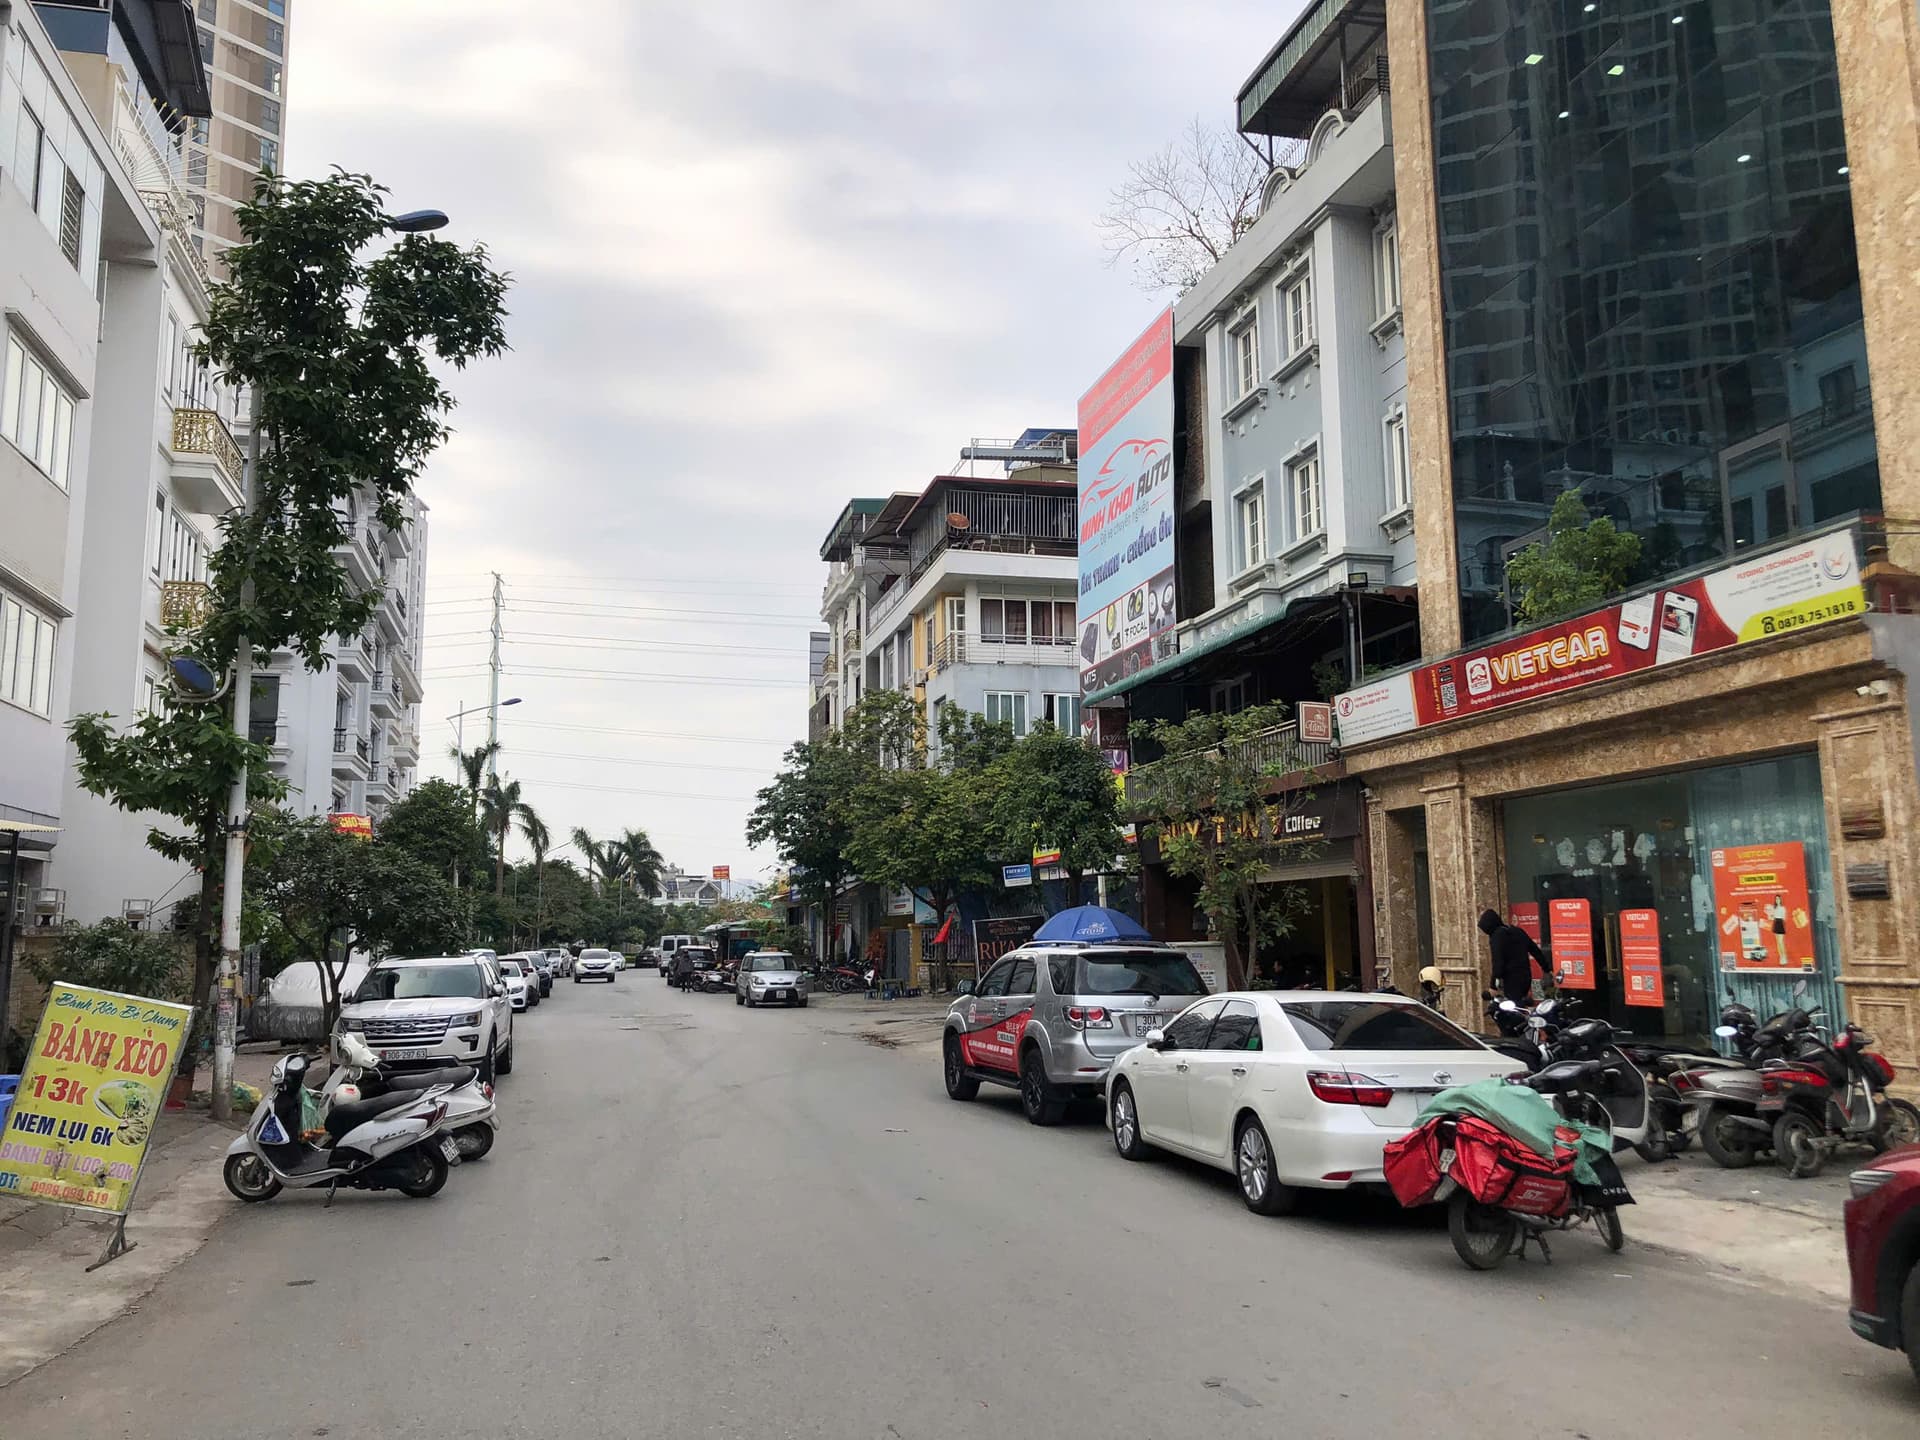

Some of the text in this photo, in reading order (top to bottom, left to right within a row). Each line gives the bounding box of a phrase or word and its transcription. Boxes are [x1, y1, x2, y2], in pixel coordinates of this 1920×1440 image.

[1080, 507, 1106, 545] MINH
[1137, 453, 1171, 501] AUTO
[1129, 619, 1148, 638] FOCAL
[1777, 600, 1856, 630] 0878.75.1818
[1490, 625, 1610, 684] VIETCAR
[1084, 668, 1097, 685] MTS
[1142, 1015, 1157, 1025] 30A
[41, 1016, 118, 1068] BÁNH
[33, 1075, 89, 1106] 13k
[12, 1111, 115, 1146] NEM LỤI 6k
